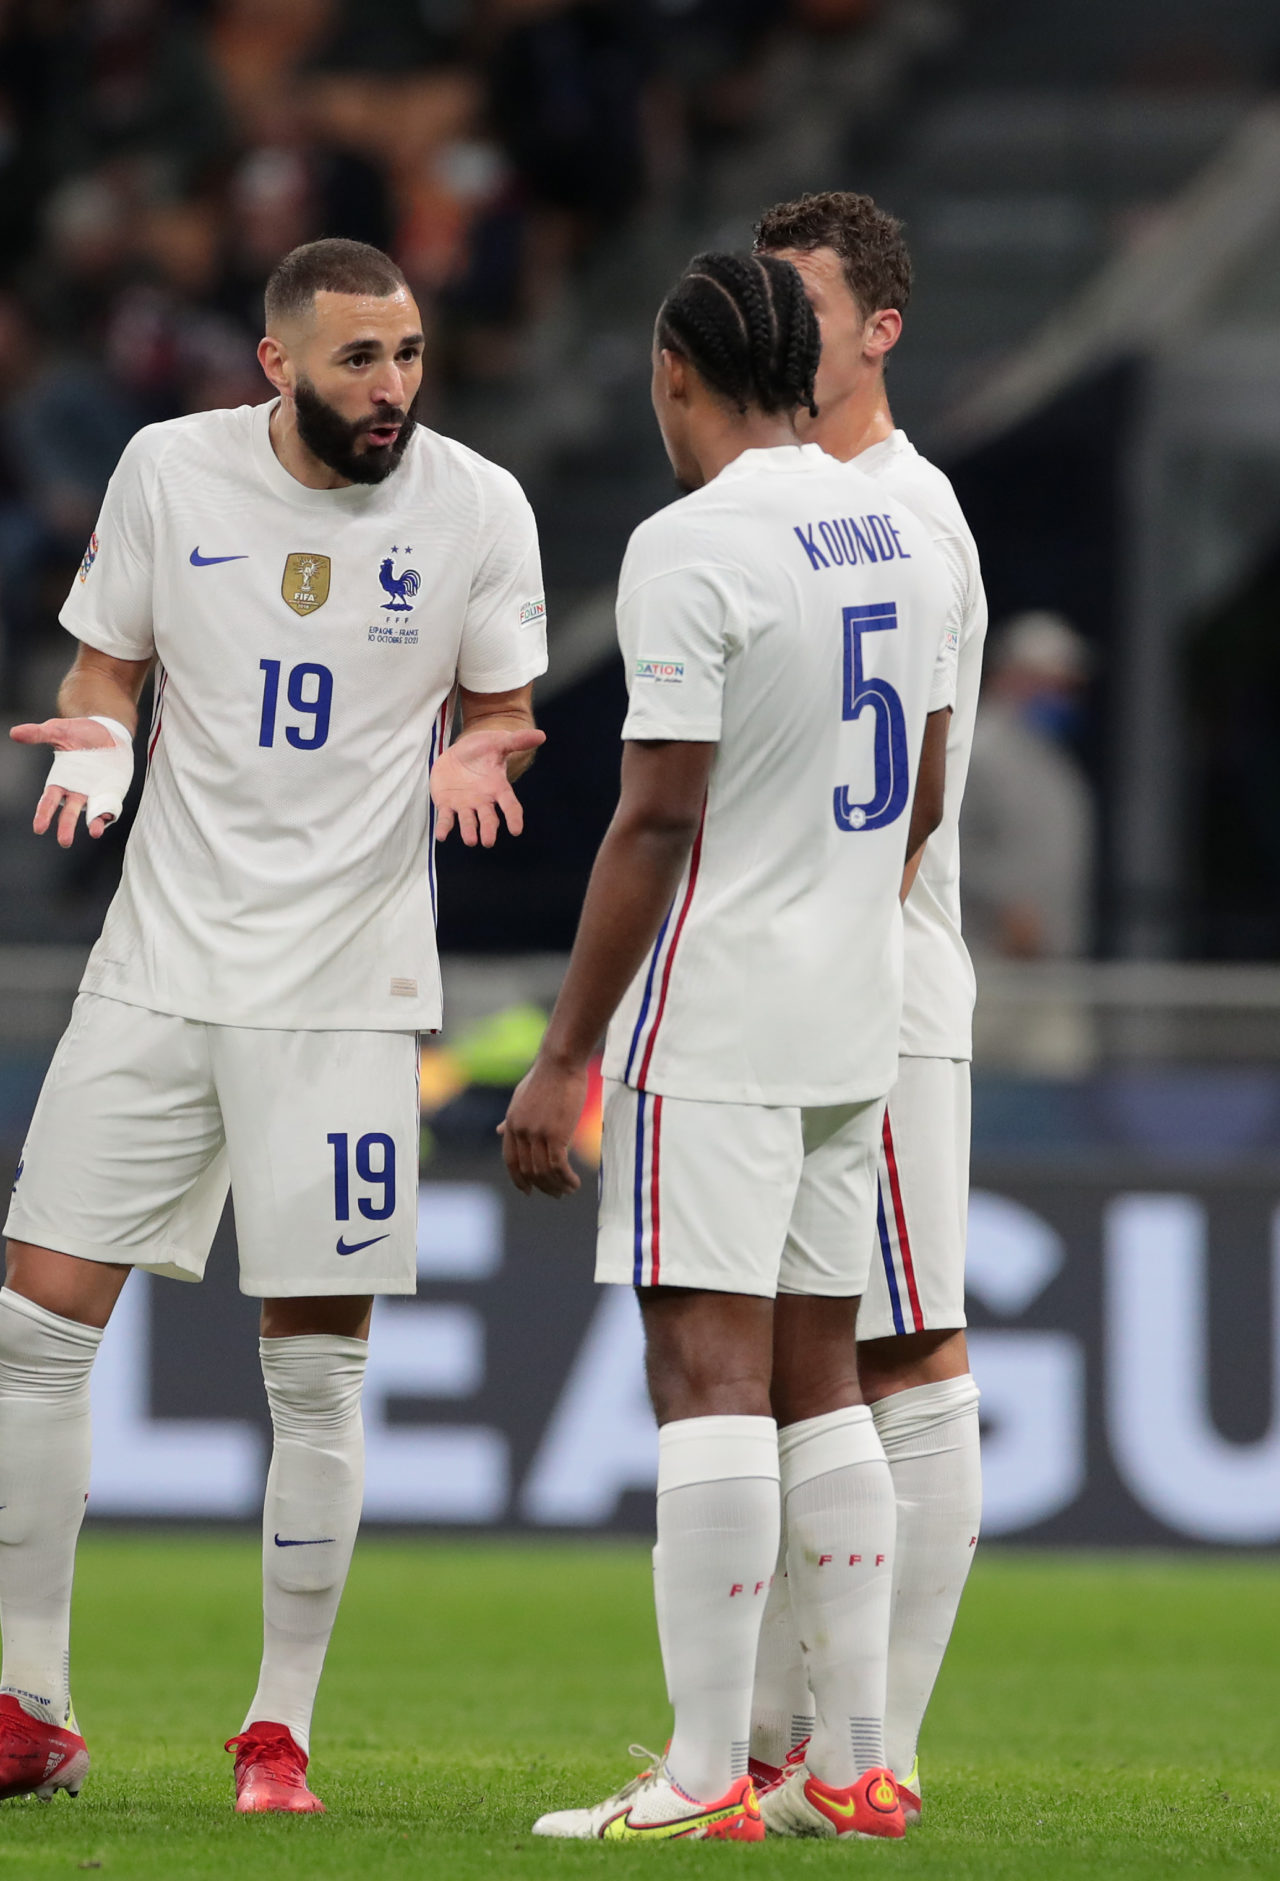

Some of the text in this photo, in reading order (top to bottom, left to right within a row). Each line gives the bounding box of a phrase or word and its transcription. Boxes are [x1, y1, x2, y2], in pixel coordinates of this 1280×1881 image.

[793, 513, 911, 572] KOUNDE
[294, 592, 315, 602] FIFA
[258, 658, 334, 751] 19
[832, 601, 910, 832] 5
[326, 1132, 396, 1221] 19
